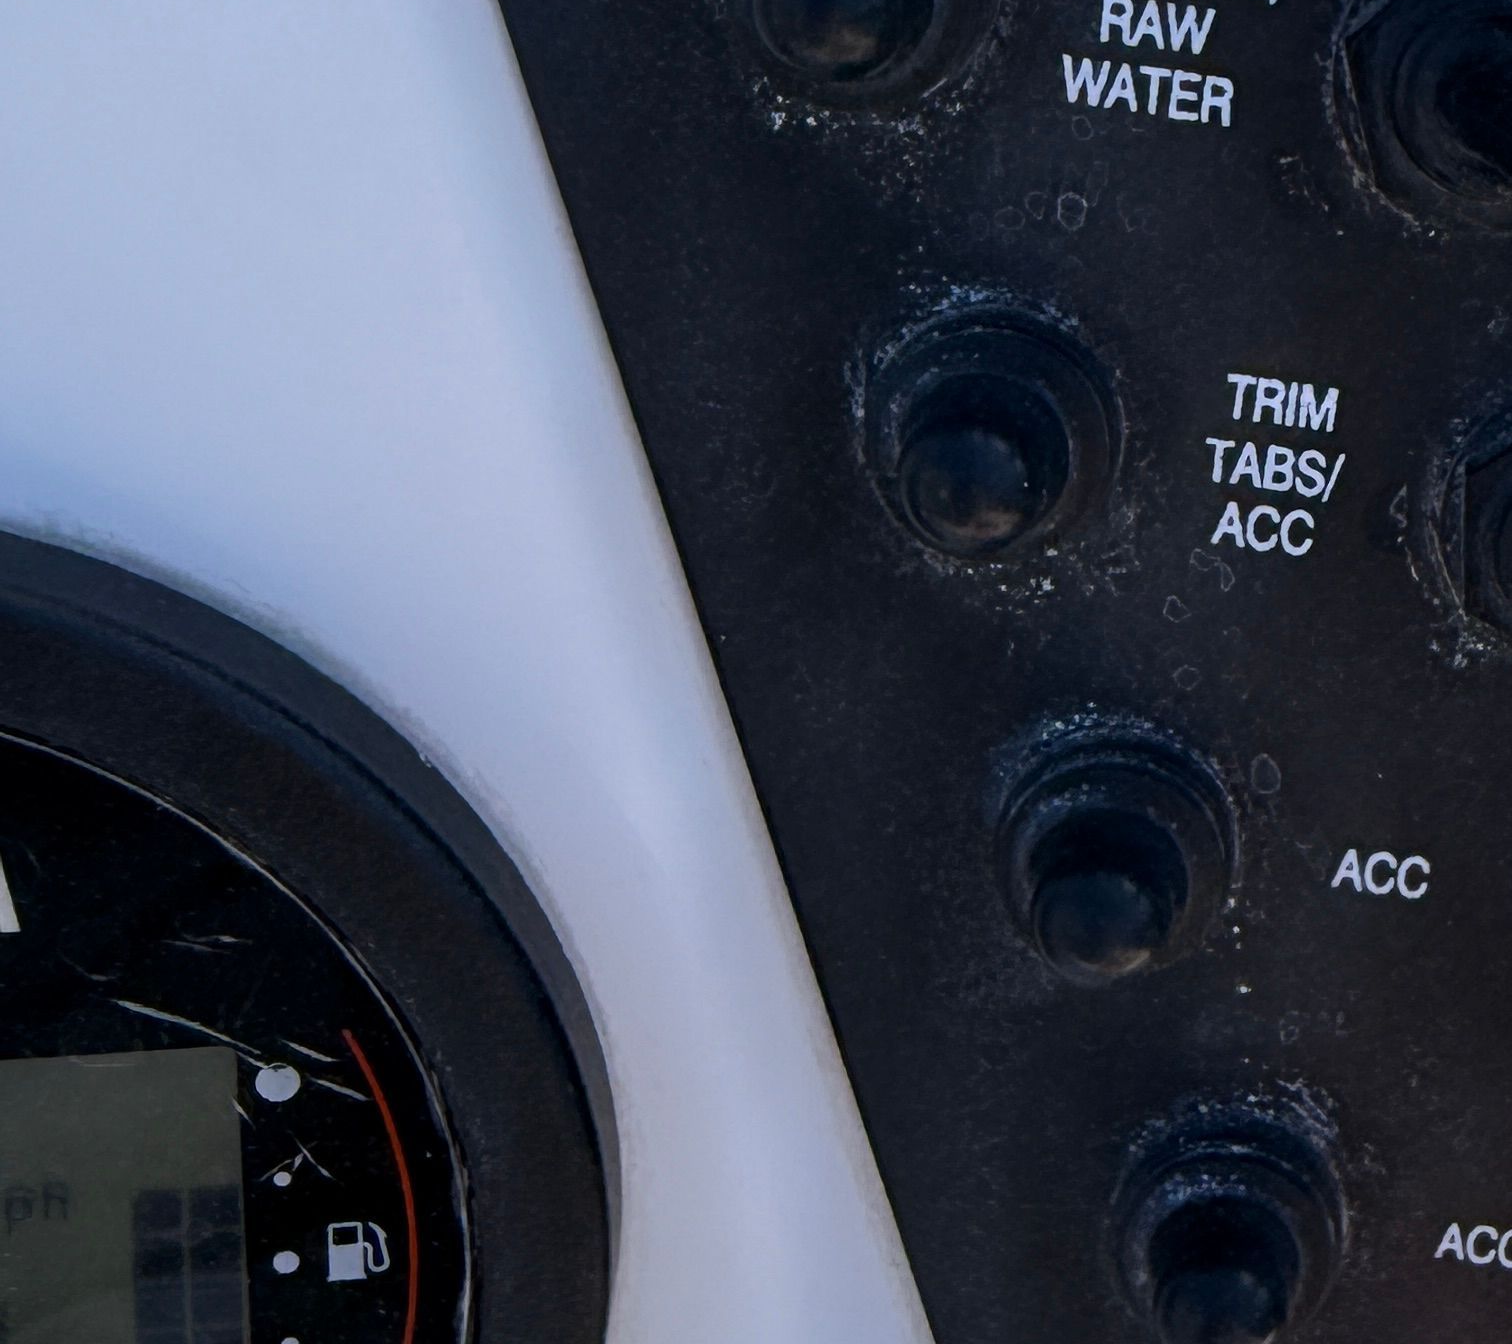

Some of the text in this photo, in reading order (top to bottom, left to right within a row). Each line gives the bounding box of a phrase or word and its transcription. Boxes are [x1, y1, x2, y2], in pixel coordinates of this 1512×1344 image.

[1061, 53, 1235, 128] WATER
[1226, 372, 1340, 433] TRIM
[1205, 436, 1346, 503] TABS/
[1210, 500, 1315, 557] ACC
[1330, 848, 1431, 900] ACC
